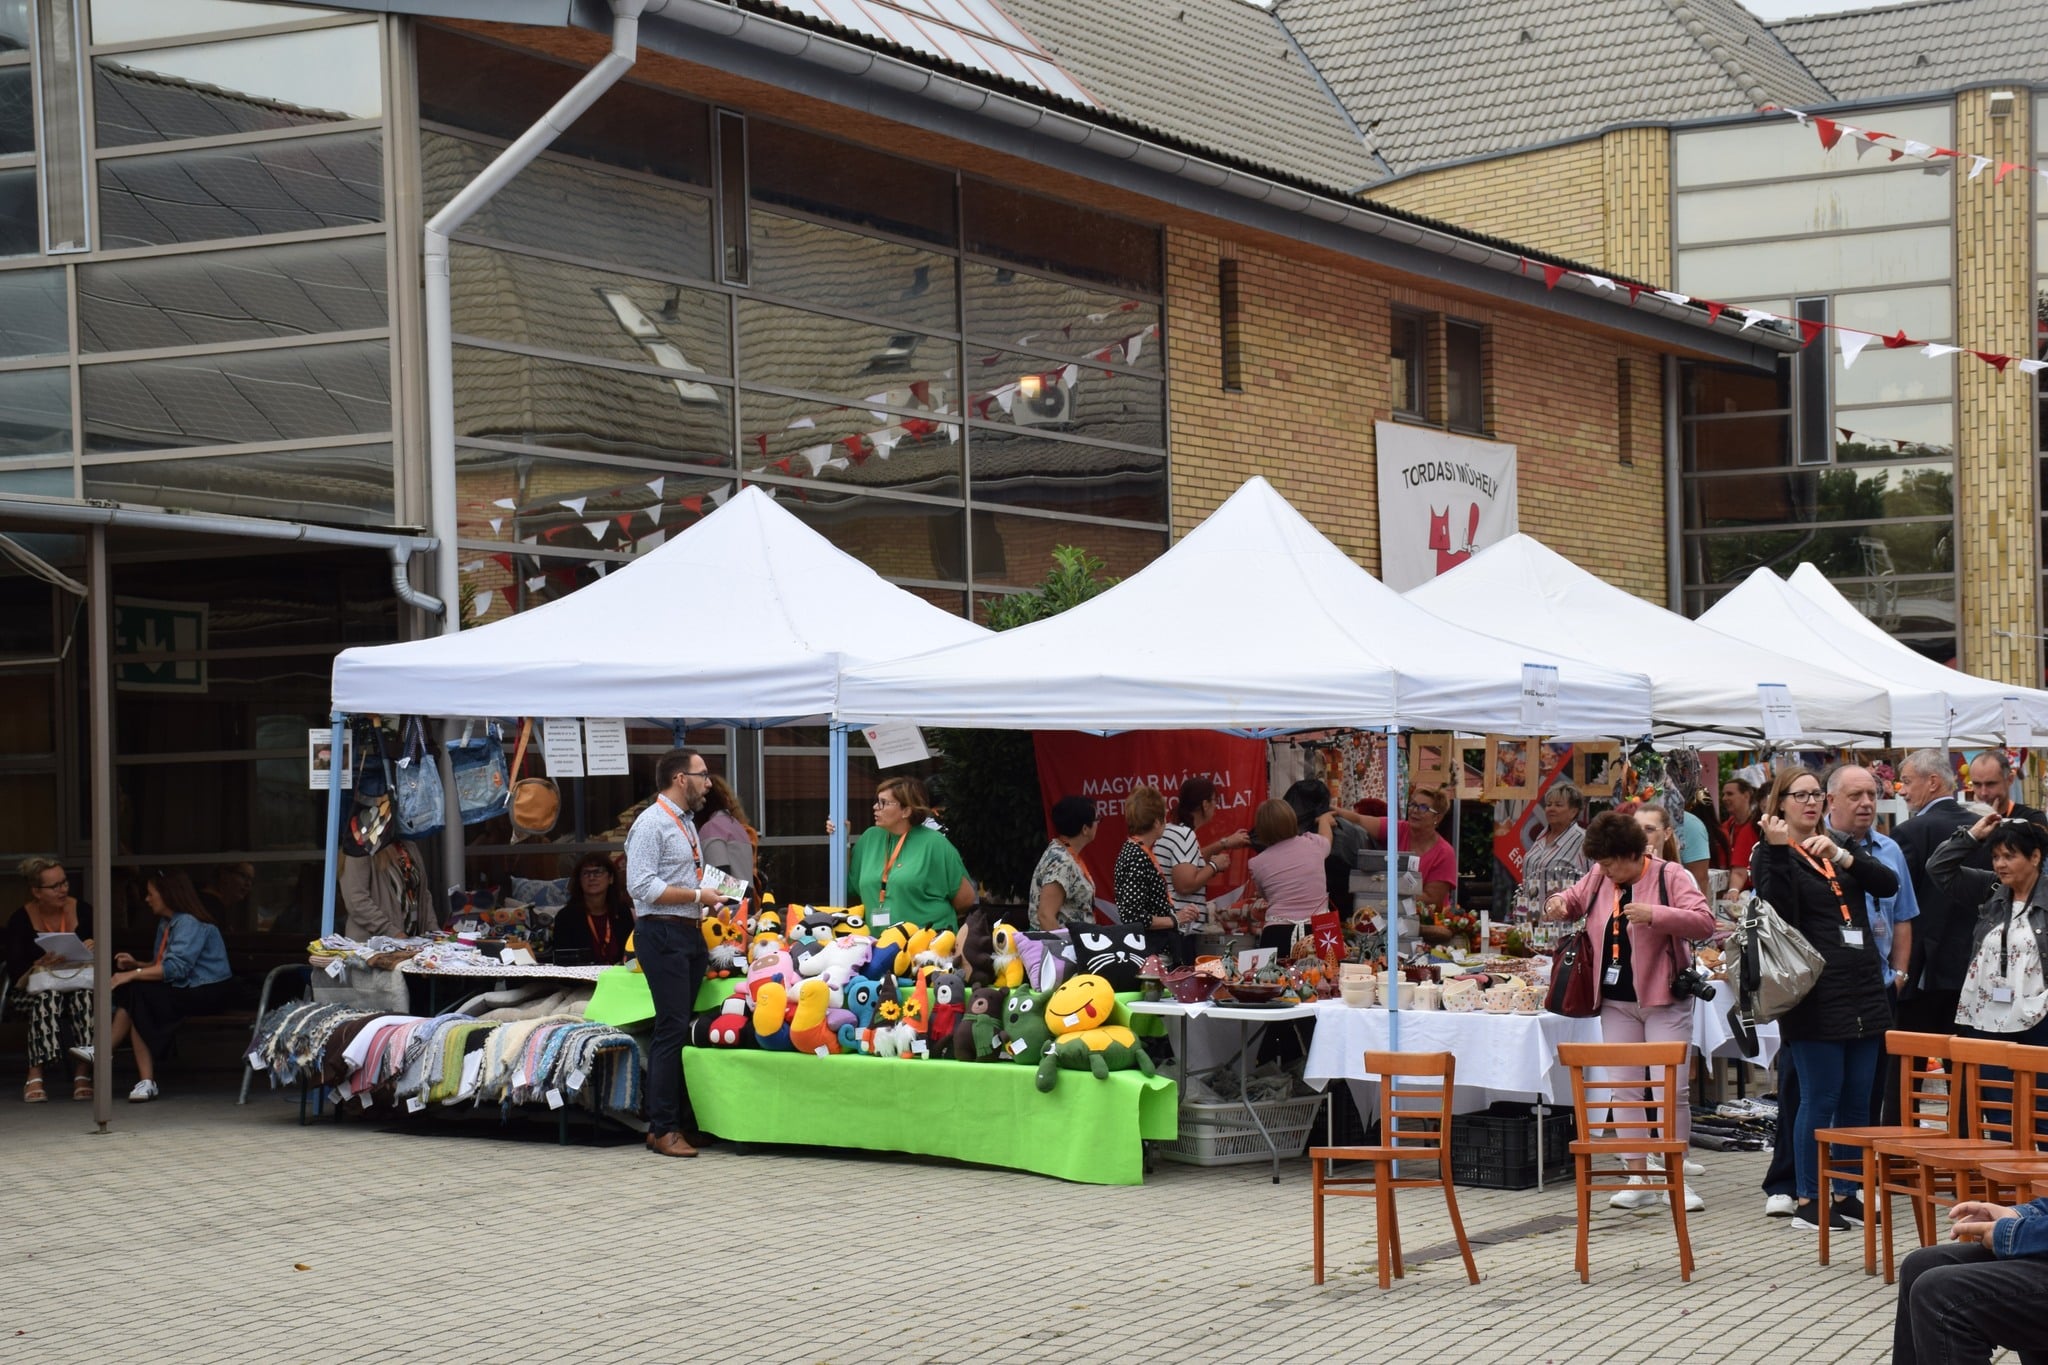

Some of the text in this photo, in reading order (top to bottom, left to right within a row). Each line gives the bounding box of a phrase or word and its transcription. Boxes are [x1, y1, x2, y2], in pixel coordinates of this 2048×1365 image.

[1402, 460, 1499, 501] TORDASI MŰHELY
[1082, 774, 1160, 796] MAGYAR
